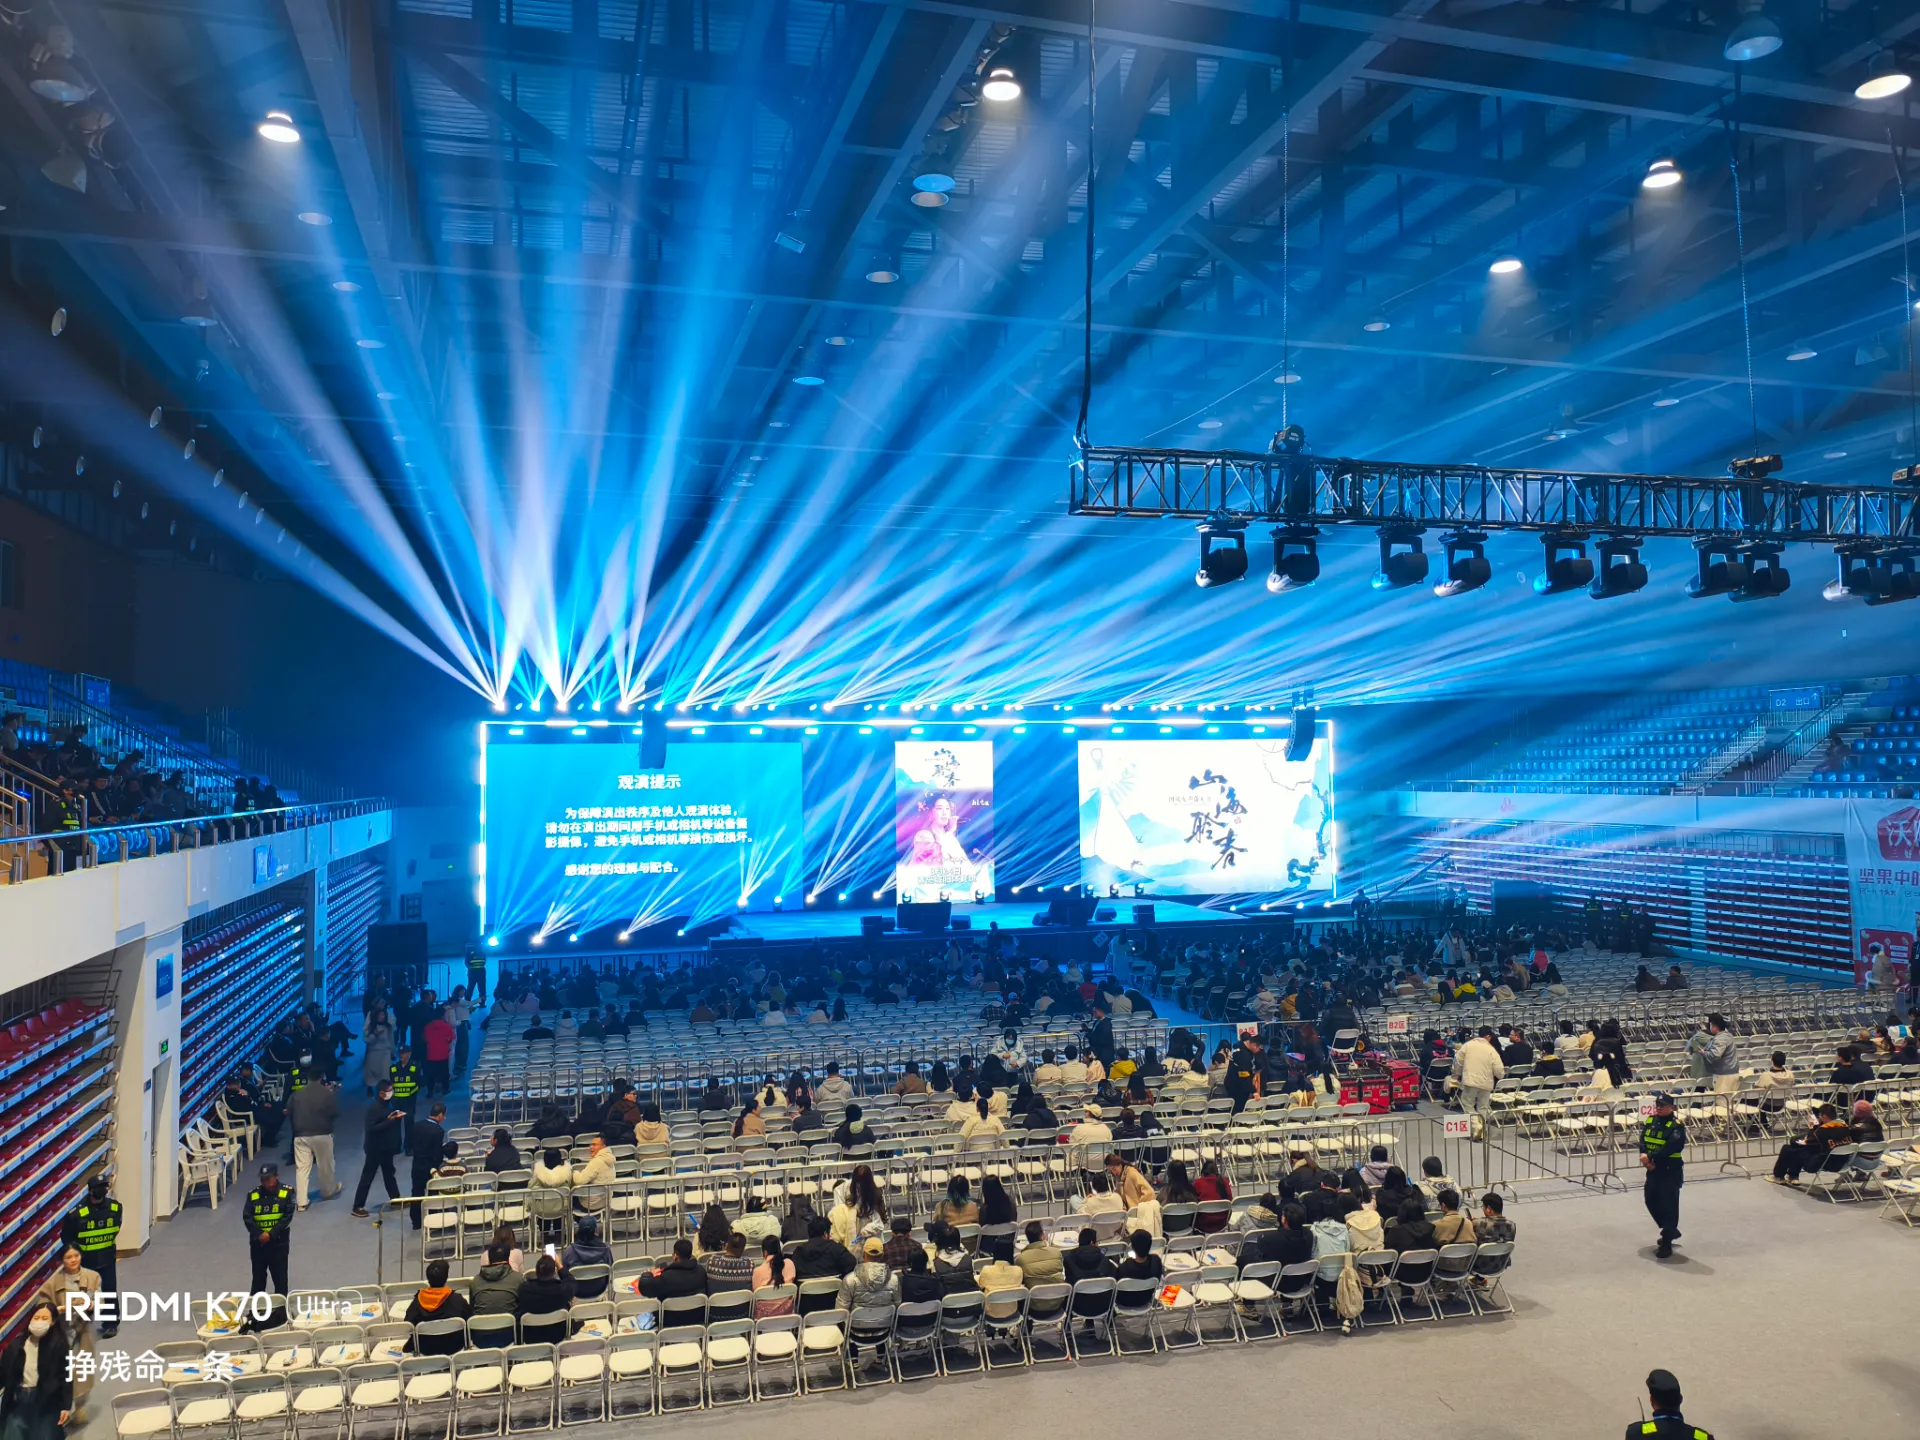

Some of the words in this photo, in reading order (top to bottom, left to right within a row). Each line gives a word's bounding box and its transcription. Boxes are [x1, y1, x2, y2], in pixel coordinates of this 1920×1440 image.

[1775, 698, 1787, 707] D2
[1795, 697, 1810, 706] 出口
[617, 774, 682, 790] 观演提示
[1389, 1020, 1405, 1030] B2区
[1446, 1120, 1468, 1132] C1区
